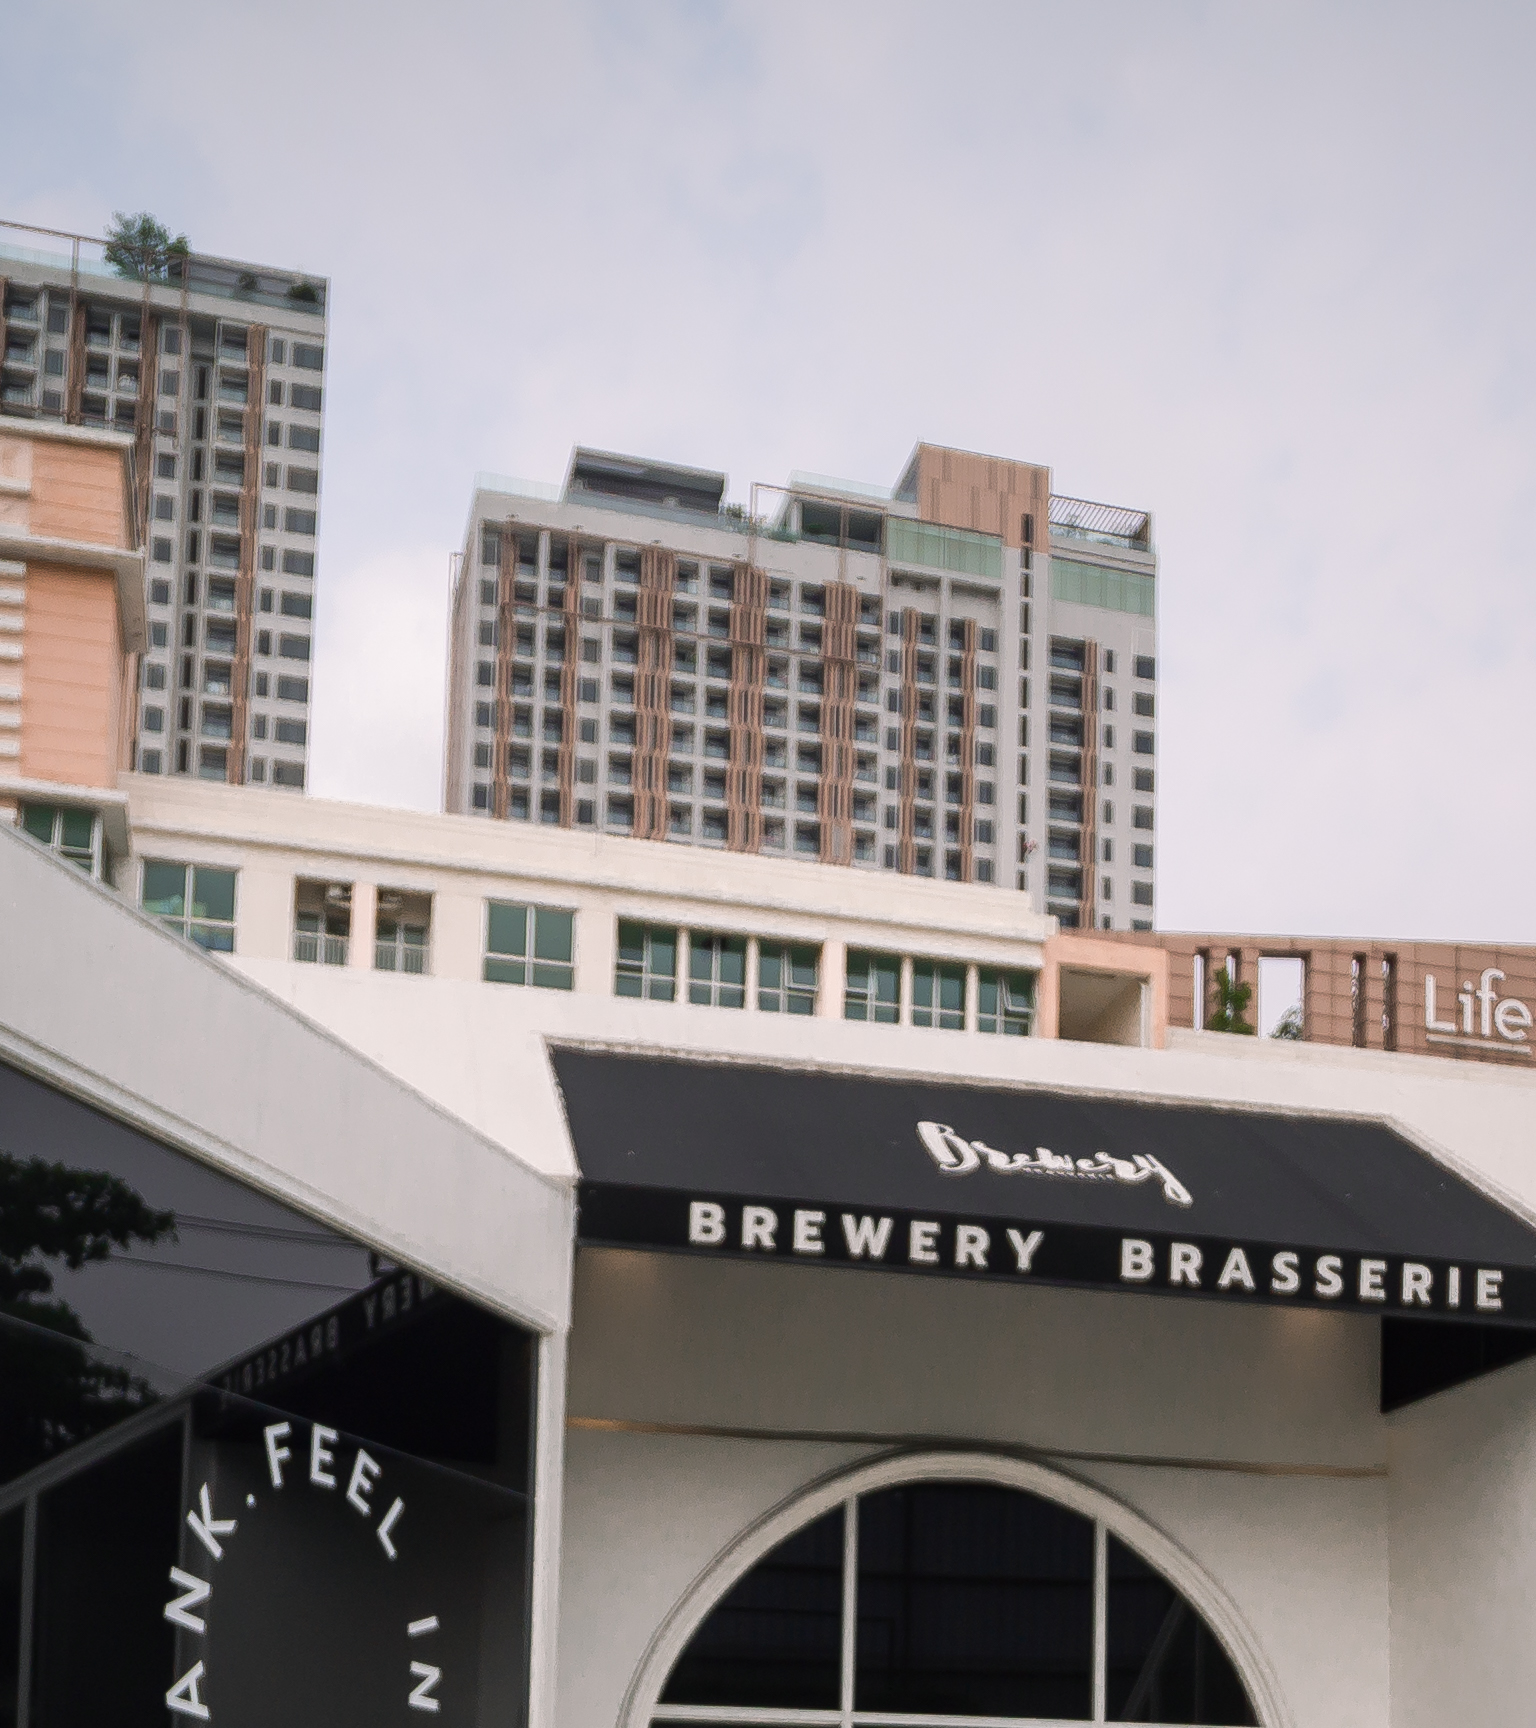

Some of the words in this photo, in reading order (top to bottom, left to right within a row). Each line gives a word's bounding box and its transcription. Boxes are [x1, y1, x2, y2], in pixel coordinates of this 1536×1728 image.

[1424, 968, 1533, 1042] Life
[688, 1200, 1046, 1274] BREWERY
[1119, 1238, 1504, 1311] BRASSERIE
[264, 1421, 405, 1560] FEEL
[407, 1615, 441, 1713] IN
